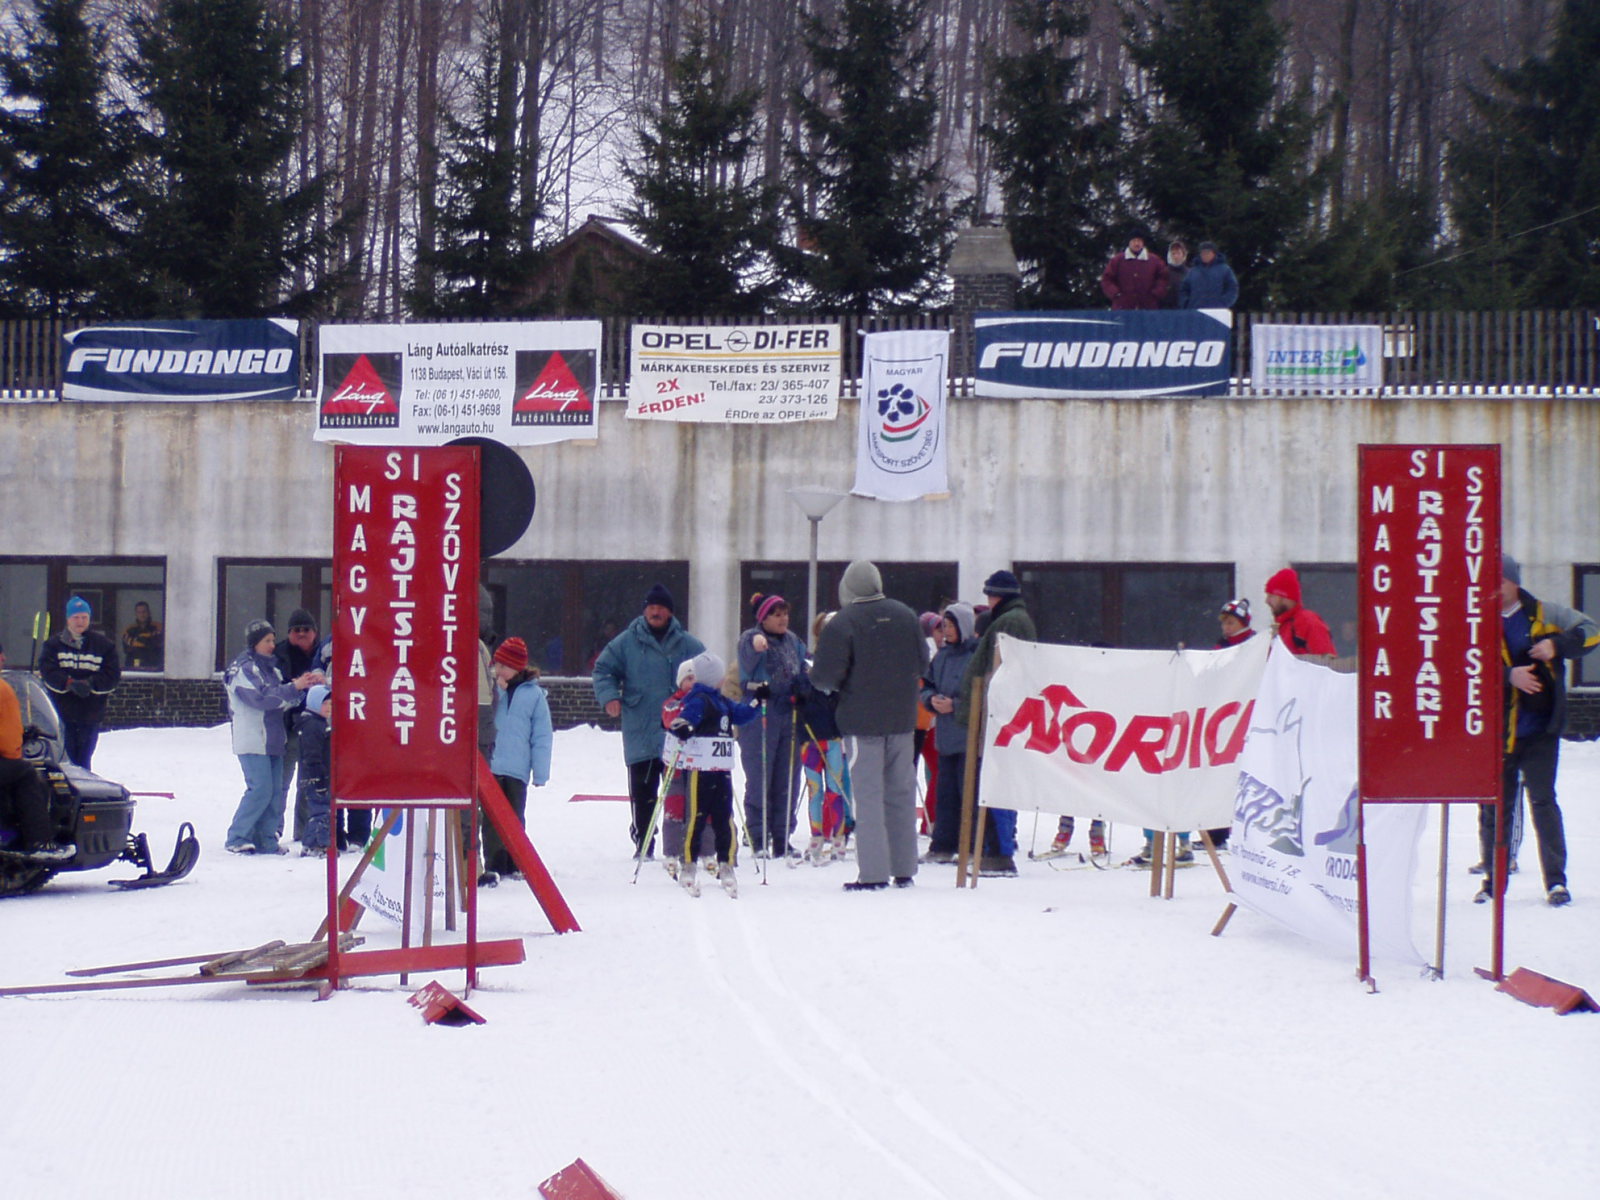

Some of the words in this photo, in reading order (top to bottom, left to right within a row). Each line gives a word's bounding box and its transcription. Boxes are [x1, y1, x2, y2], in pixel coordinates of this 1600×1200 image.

[641, 332, 722, 350] OPEL
[753, 329, 830, 350] DI-FER
[407, 342, 433, 360] Láng
[436, 341, 509, 356] Autóalkatrész
[979, 341, 1226, 368] FUNDANGO
[66, 348, 293, 375] FUNDANGO
[640, 361, 759, 373] MÁRKAKERESKEDÉS
[762, 362, 777, 373] ÉS
[780, 363, 830, 373] SZERVIZ
[411, 367, 427, 380] 1138
[428, 367, 464, 383] Budapest,
[466, 366, 482, 380] Váci
[484, 366, 492, 380] út
[886, 367, 923, 376] MAGYAR
[656, 377, 680, 394] 2X
[760, 380, 780, 391] 23/
[782, 379, 830, 390] 365-407
[332, 382, 386, 415] Láng
[415, 389, 431, 400] Tel:
[525, 379, 580, 412] Láng
[637, 392, 706, 414] ÉRDEN!
[758, 394, 778, 404] 23/
[779, 394, 828, 404] 373-126
[412, 404, 431, 417] Fax:
[433, 404, 459, 418] (06-1)
[461, 403, 501, 416] 451-9698
[762, 411, 775, 419] az
[417, 421, 494, 436] www.langauto.hu
[349, 484, 371, 720] MAGYAR
[1371, 485, 1395, 720] MAGYAR
[711, 741, 733, 757] 203
